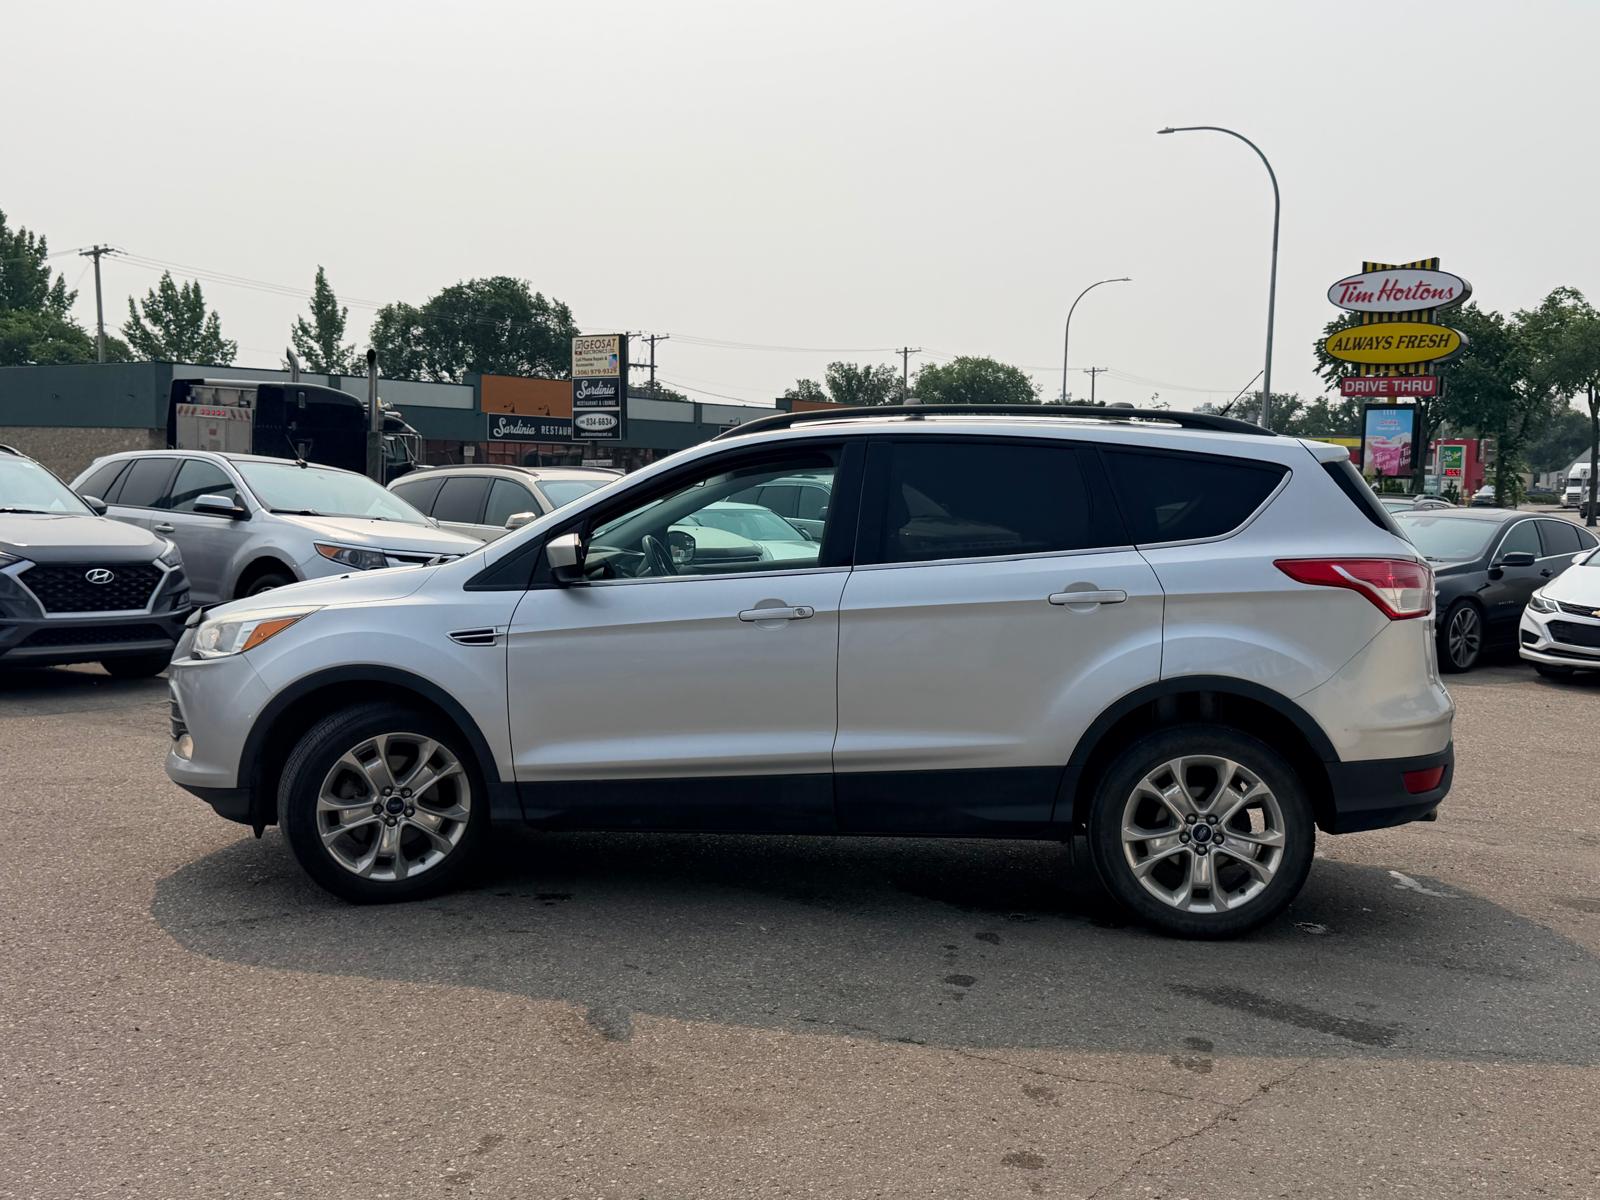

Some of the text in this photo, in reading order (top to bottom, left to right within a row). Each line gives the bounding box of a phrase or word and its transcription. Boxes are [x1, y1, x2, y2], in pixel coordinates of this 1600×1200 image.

[1338, 278, 1454, 305] Tim Hortons
[584, 338, 617, 349] GEOSAT
[1332, 333, 1452, 352] ALWAYS FRESH
[576, 380, 616, 399] Sardinia
[1344, 380, 1433, 393] DRIVE THRU
[493, 417, 537, 437] Sardinia
